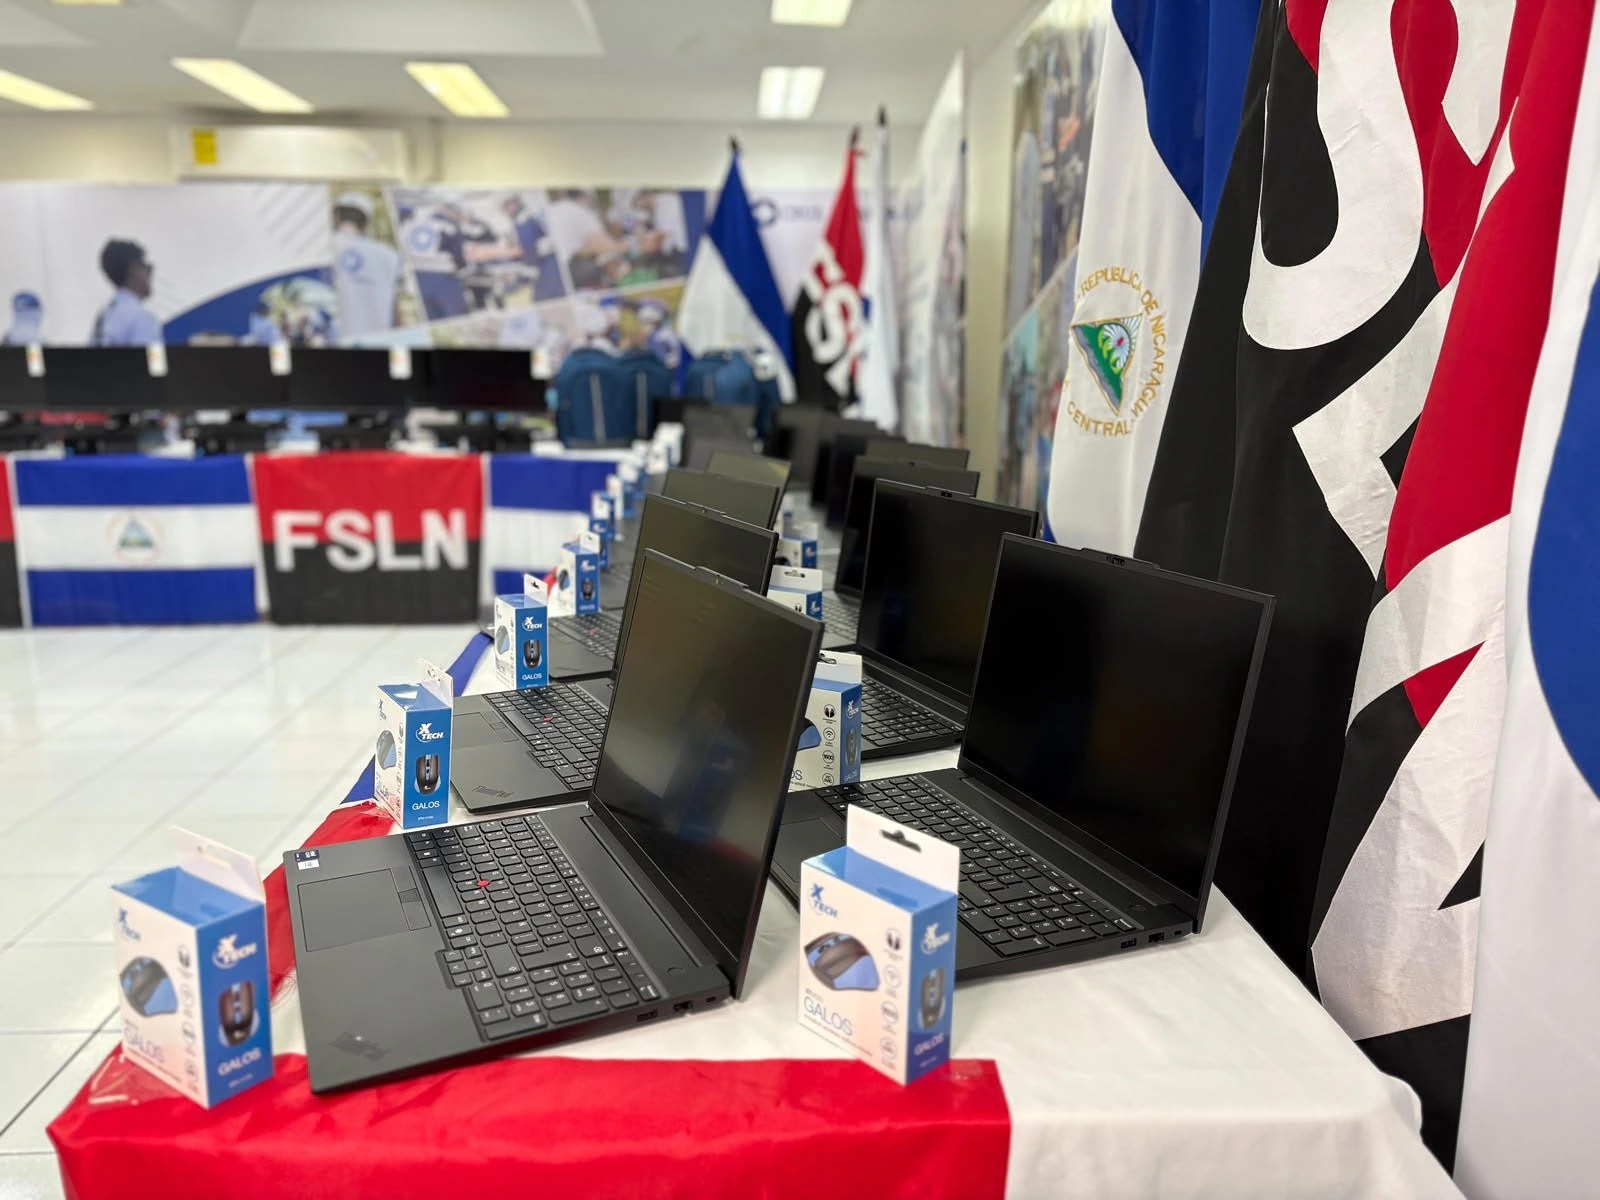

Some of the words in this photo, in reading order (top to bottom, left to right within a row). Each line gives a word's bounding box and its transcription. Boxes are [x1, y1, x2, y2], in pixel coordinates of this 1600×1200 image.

[1141, 289, 1159, 315] DE
[1067, 401, 1130, 437] CENTRAL
[273, 508, 469, 572] FSLN
[411, 800, 440, 811] GALOS
[803, 995, 854, 1037] GALOS
